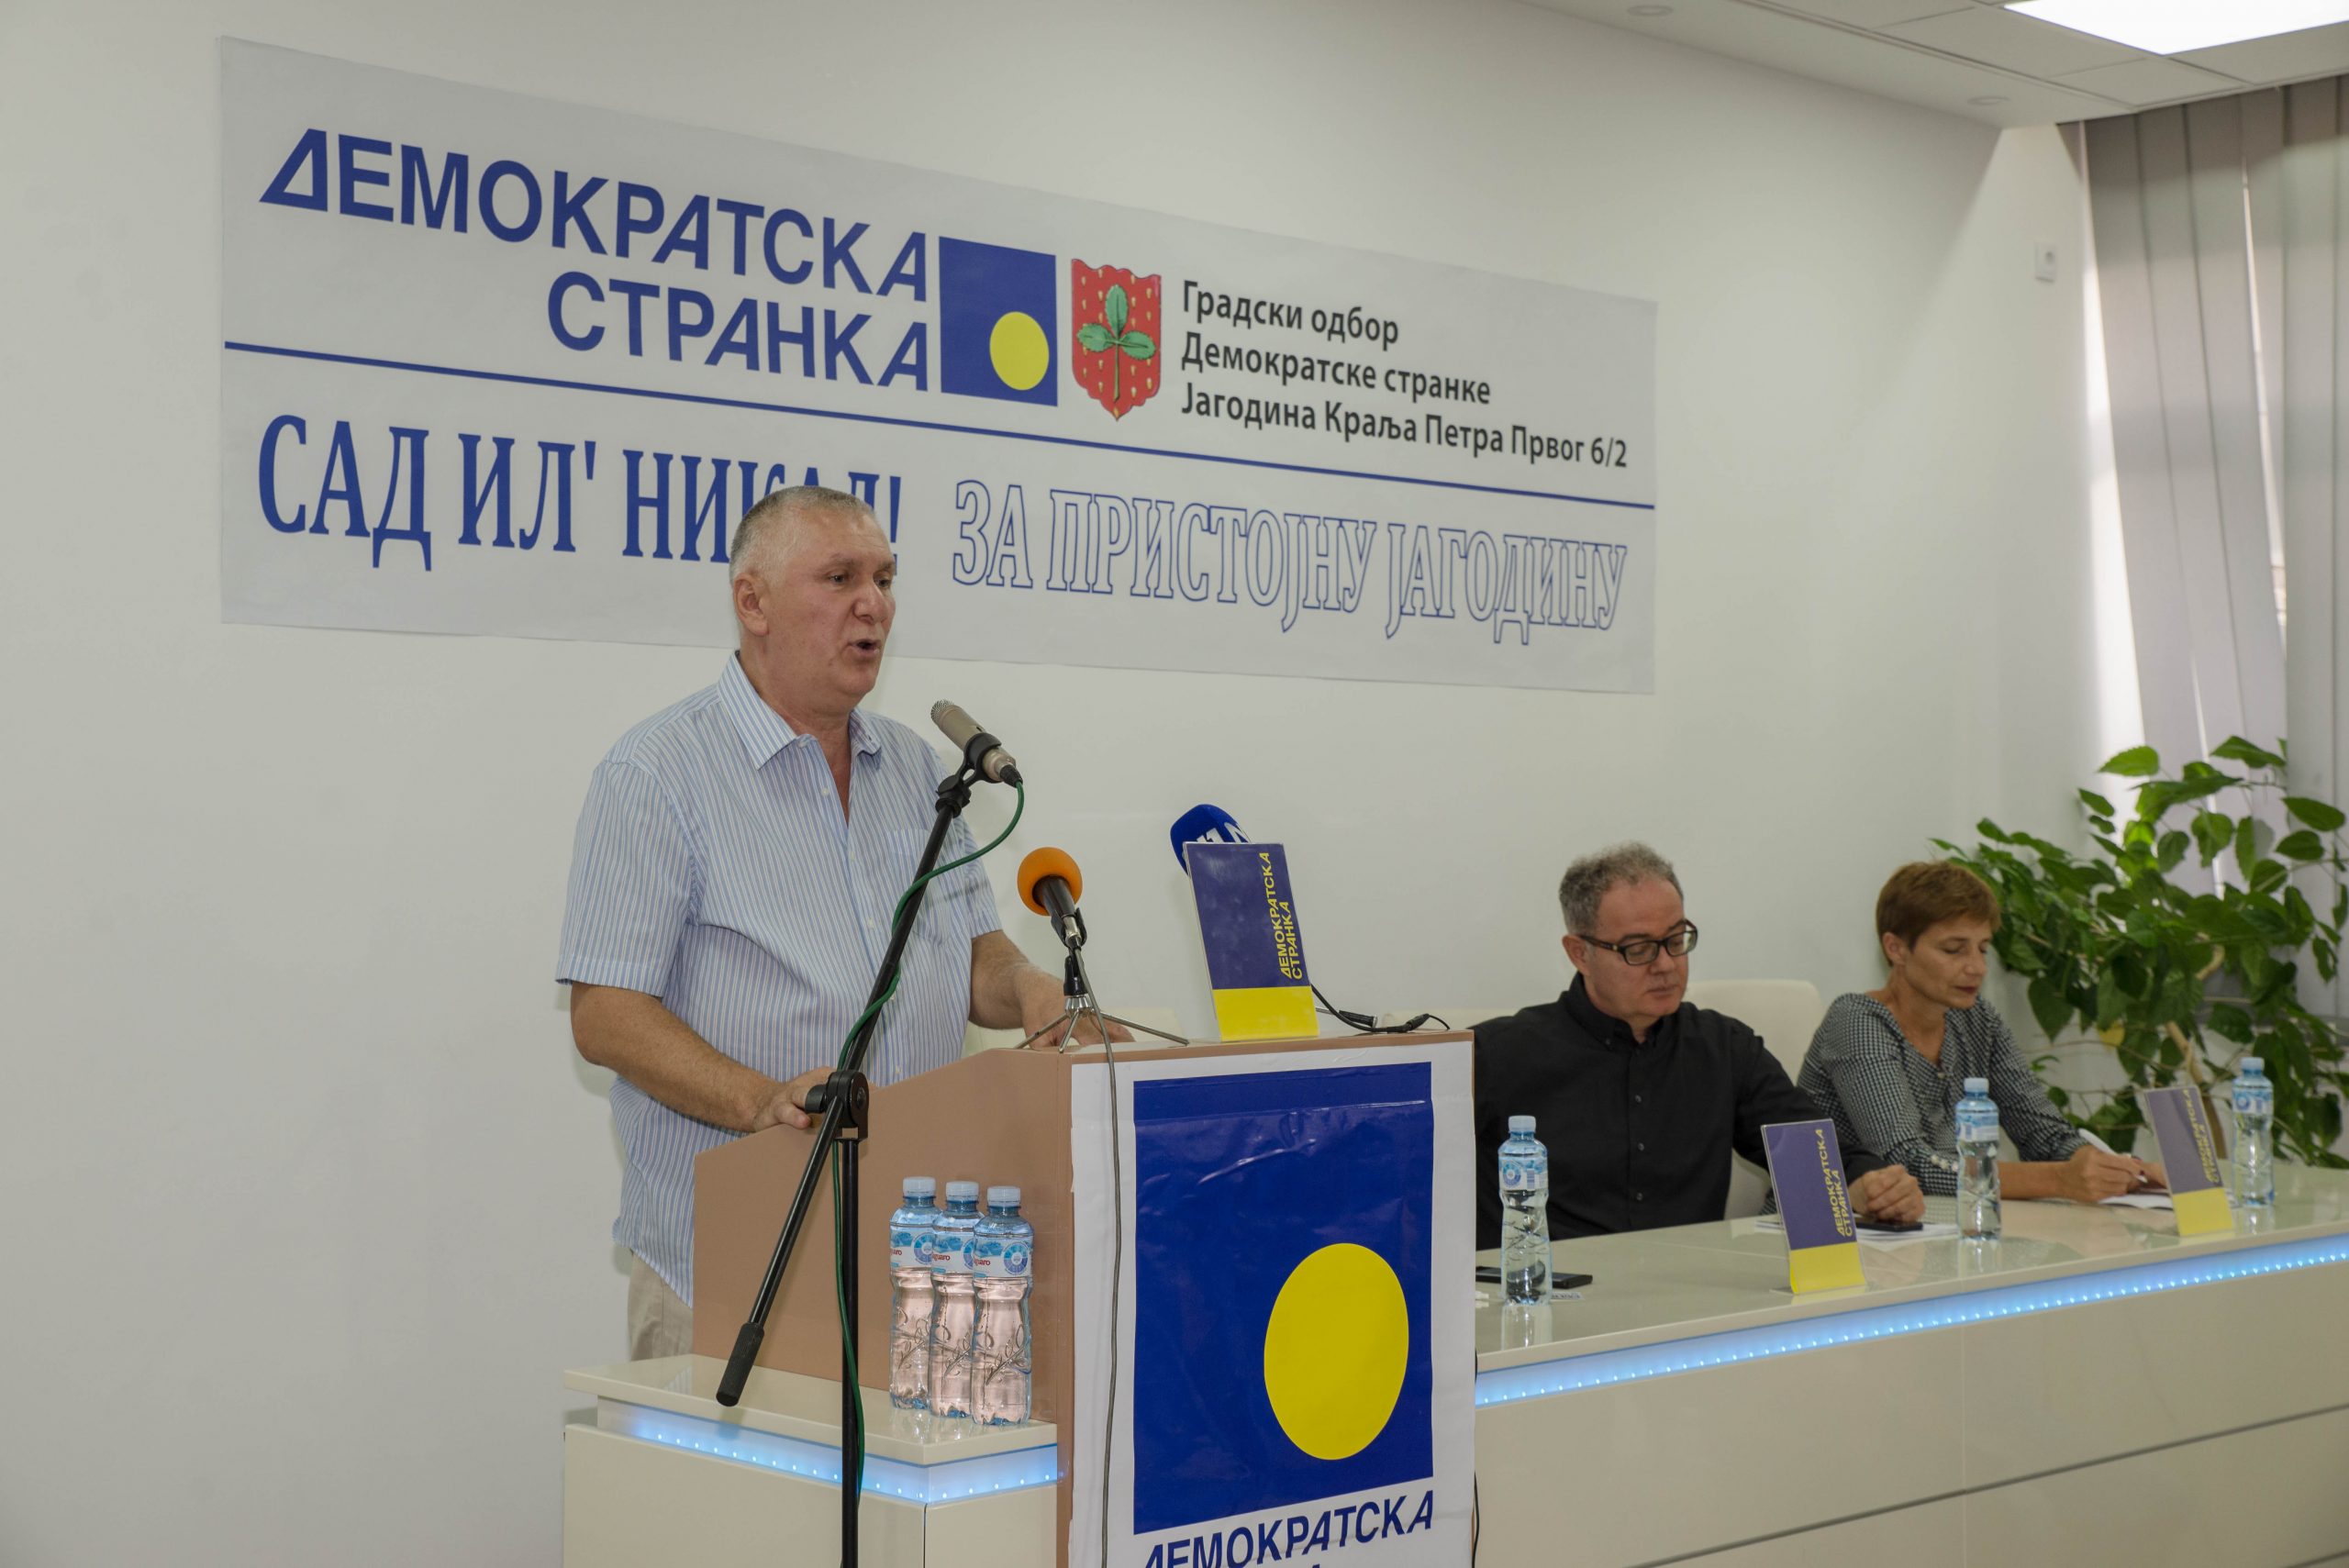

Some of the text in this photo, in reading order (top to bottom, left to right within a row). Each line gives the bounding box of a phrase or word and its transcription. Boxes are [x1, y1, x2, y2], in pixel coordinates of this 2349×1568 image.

[259, 128, 928, 303] ДЕМОКРАТСКА
[548, 271, 929, 393] СТРАНКА
[1183, 279, 1399, 351] Градски одбор
[1181, 330, 1491, 405] Демократске странке
[1181, 382, 1628, 468] Јагодина Краља Петра Првог 6/2
[258, 414, 433, 572] САД
[622, 449, 902, 576] НИ!
[952, 479, 1628, 645] ЗА ПРИСТОЈНУ ЈАГОДИНУ
[1278, 901, 1303, 980] СТРАНКА
